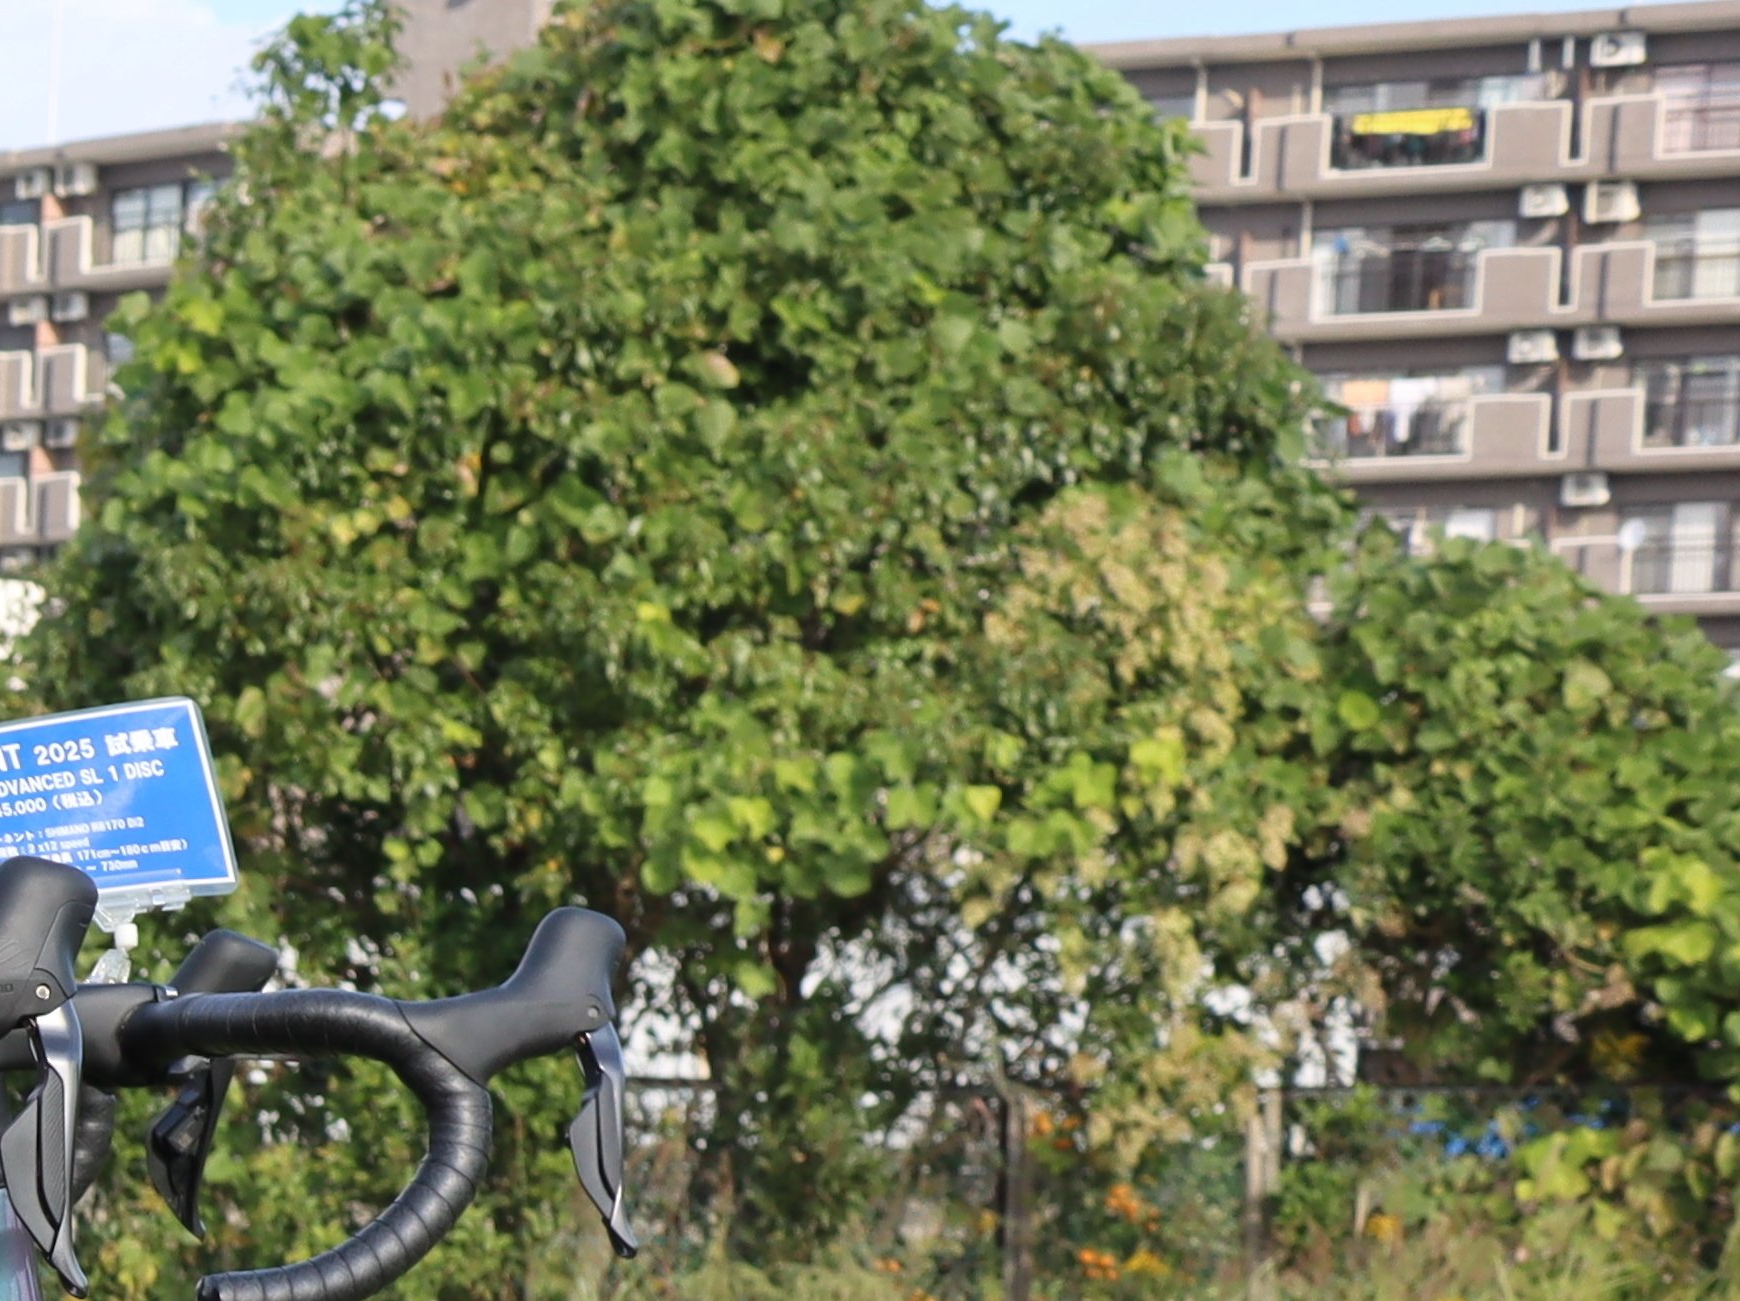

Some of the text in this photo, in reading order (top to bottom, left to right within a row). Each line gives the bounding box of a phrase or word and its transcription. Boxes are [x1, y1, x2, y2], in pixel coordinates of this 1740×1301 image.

[33, 738, 96, 766] 2025
[105, 727, 179, 757] 試乗車
[79, 769, 104, 785] SL
[107, 766, 119, 782] 1
[124, 759, 165, 780] DISC
